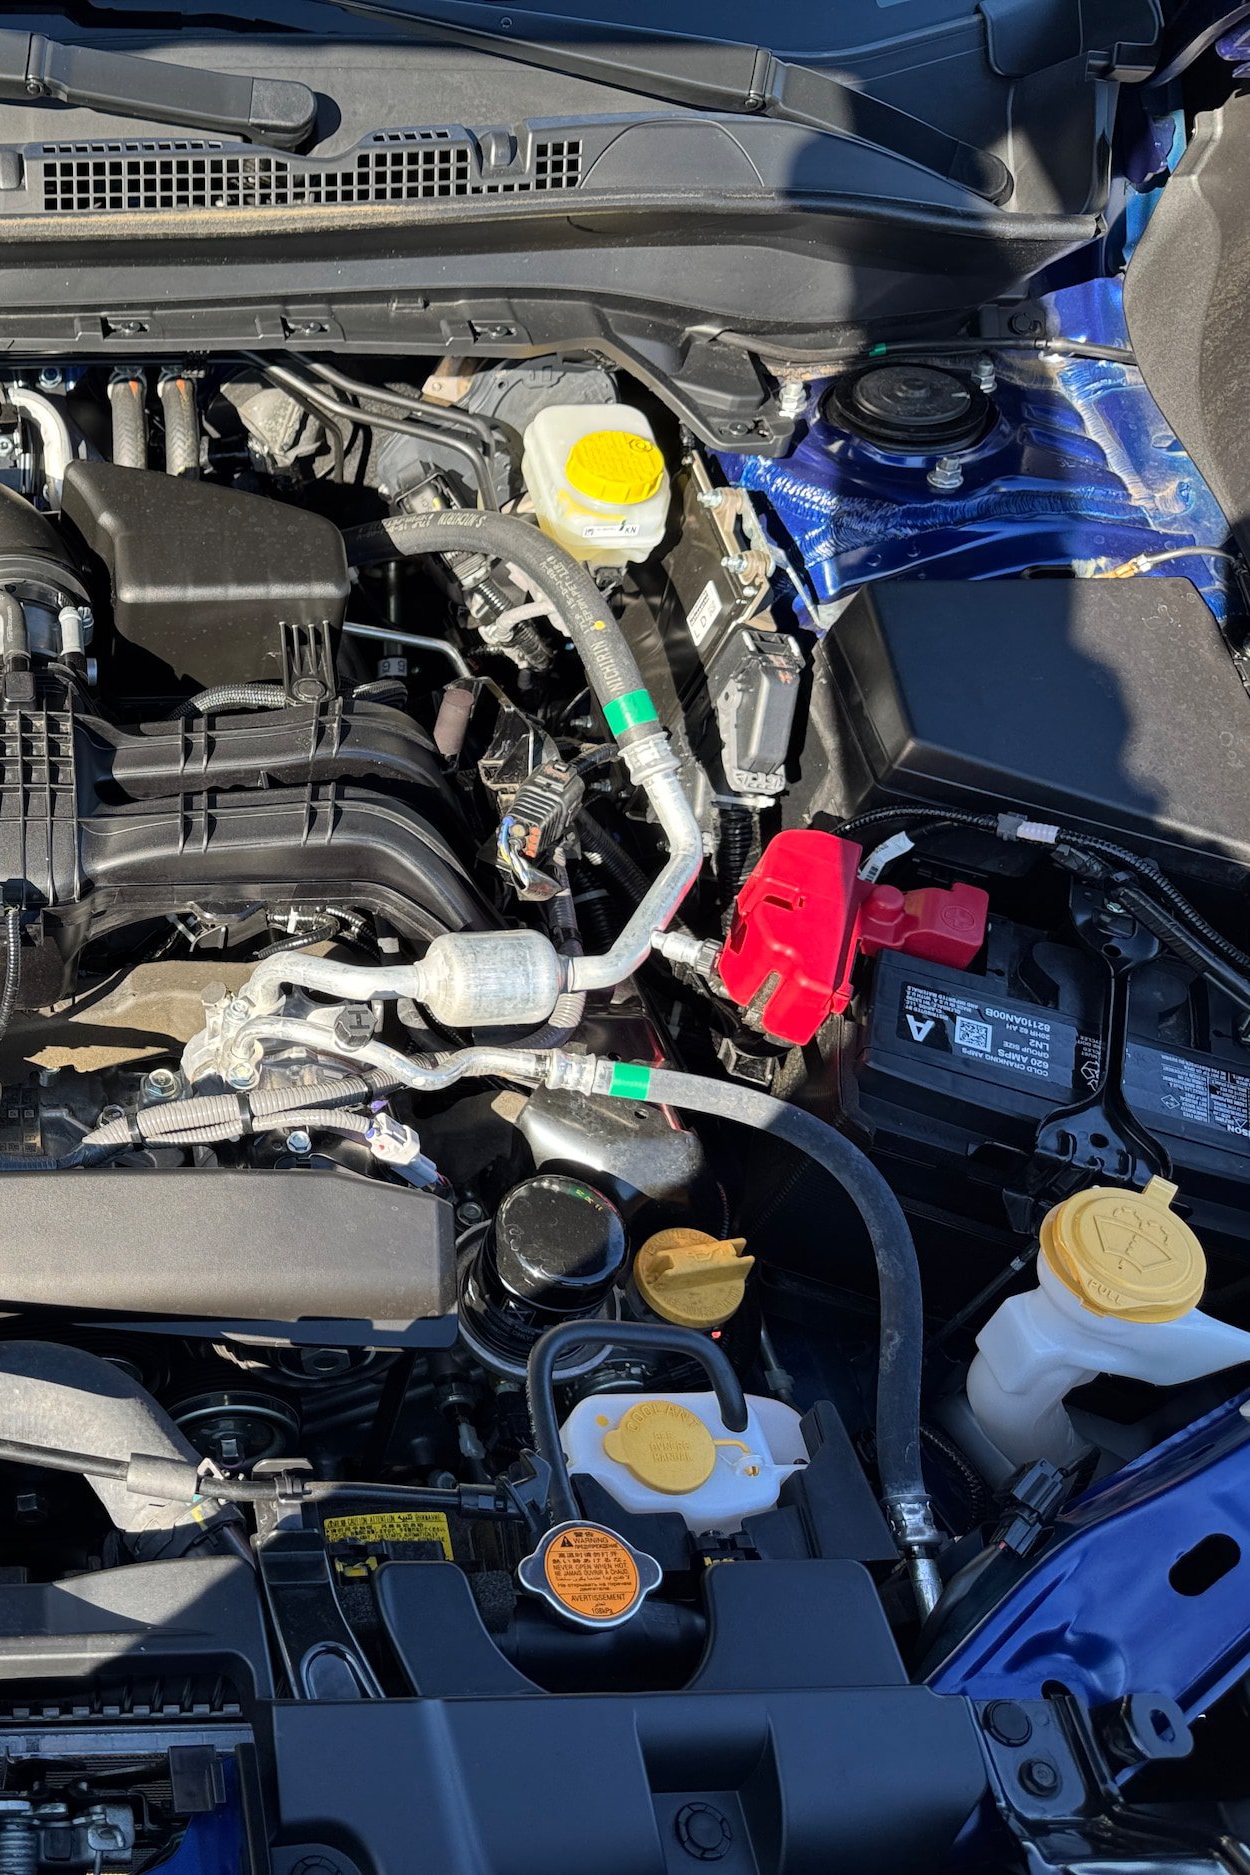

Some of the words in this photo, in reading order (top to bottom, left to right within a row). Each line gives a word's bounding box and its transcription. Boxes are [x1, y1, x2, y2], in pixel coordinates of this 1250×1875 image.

[984, 1006, 1051, 1032] 82110AN00B
[906, 1014, 935, 1042] A
[1002, 1040, 1020, 1050] SIZE
[1027, 1038, 1050, 1051] LN2
[960, 1046, 983, 1058] AMPS
[996, 1048, 1028, 1063] AMPS
[1020, 1045, 1049, 1058] GROUP
[984, 1053, 1025, 1070] CRANKING
[1029, 1057, 1049, 1069] 620
[1025, 1065, 1049, 1076] COLD
[1087, 1279, 1125, 1305] PULL
[625, 1403, 699, 1432] COOLANT
[571, 1593, 625, 1601] AVERTISSEMENT
